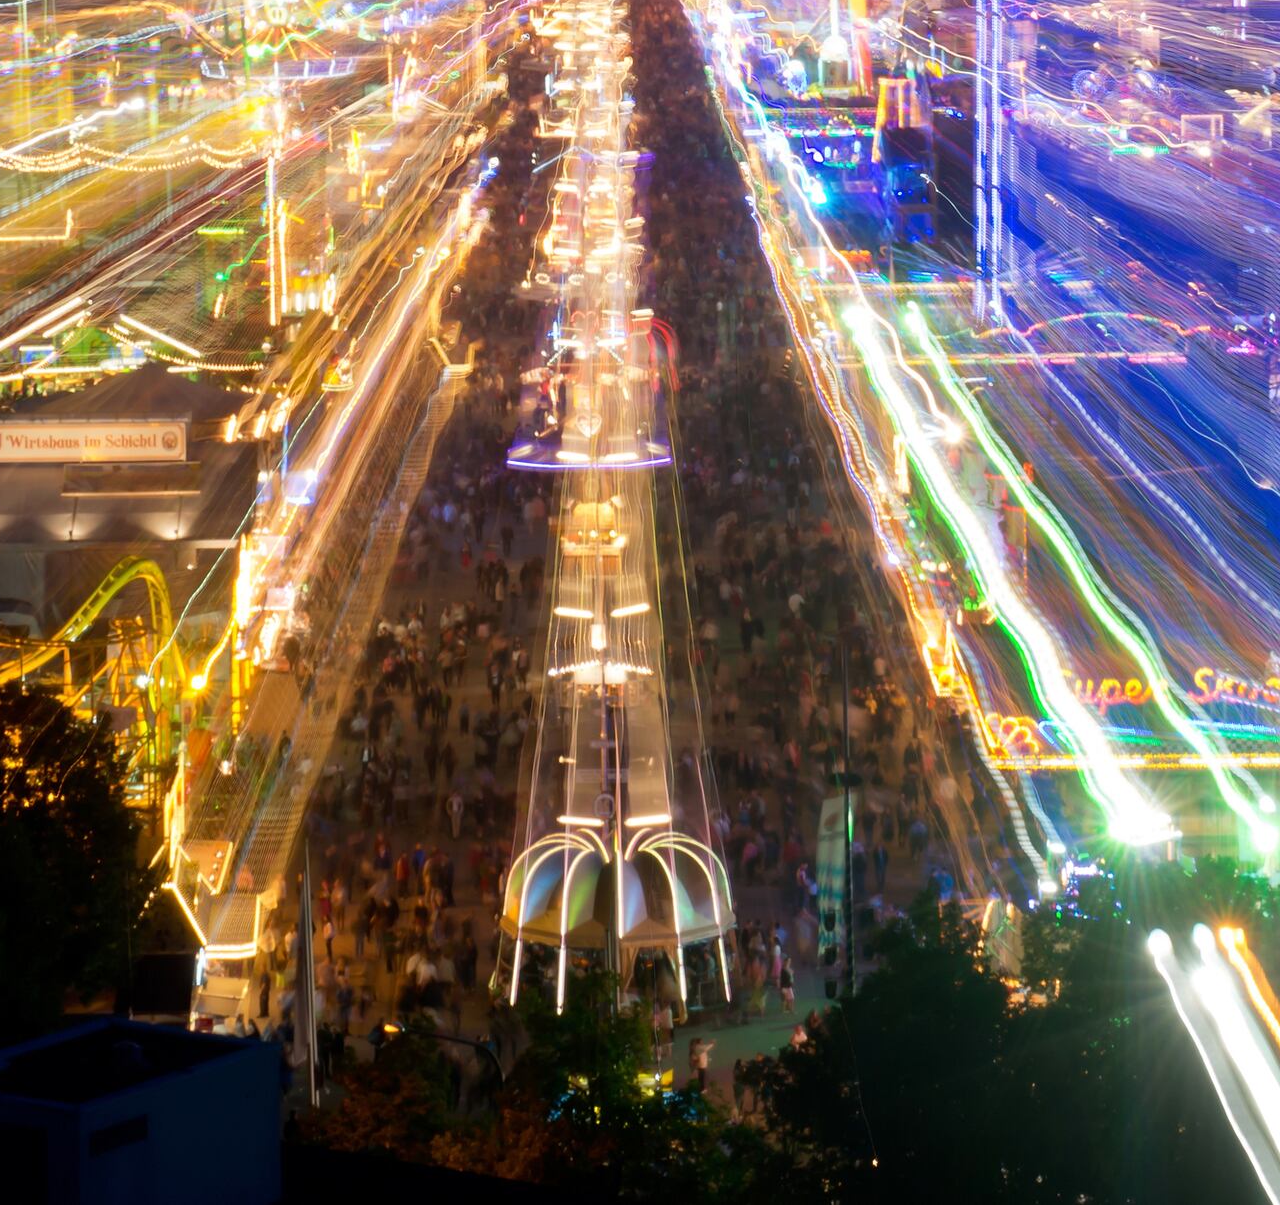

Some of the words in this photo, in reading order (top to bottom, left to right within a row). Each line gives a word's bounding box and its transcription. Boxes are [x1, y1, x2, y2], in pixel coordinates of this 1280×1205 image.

[6, 435, 80, 450] Wirtshaus
[84, 435, 101, 448] im
[105, 434, 156, 449] Schichtl
